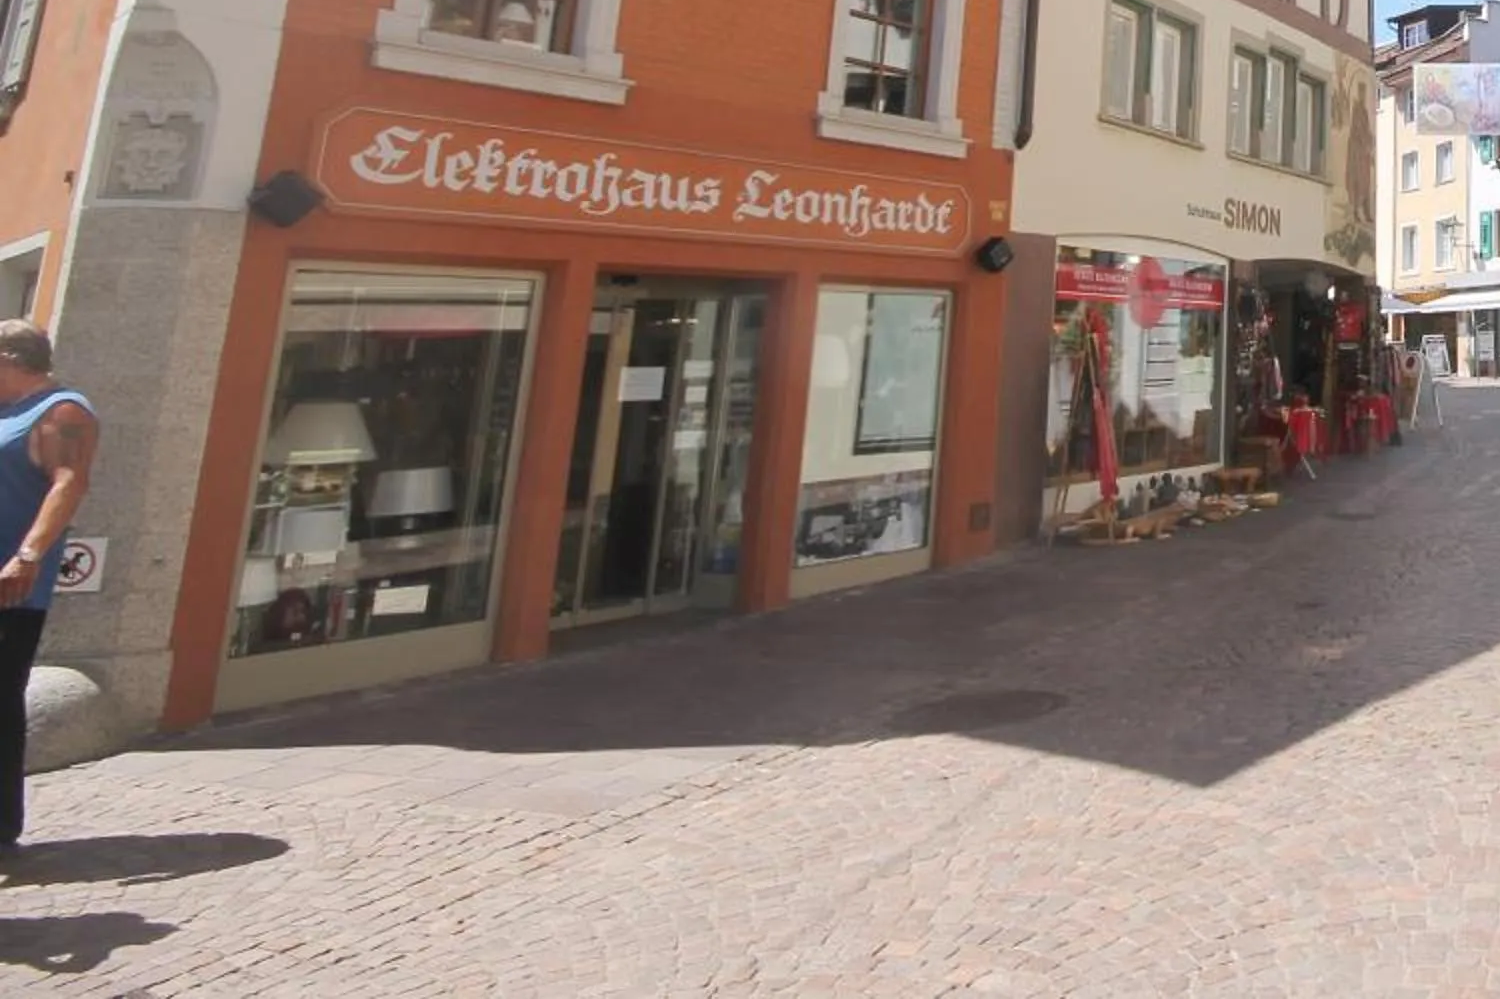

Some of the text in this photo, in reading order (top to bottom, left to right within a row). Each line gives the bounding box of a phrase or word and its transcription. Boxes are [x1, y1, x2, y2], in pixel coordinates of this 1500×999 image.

[349, 125, 955, 238] Elektrohaus Leonhardt
[1223, 197, 1281, 237] SIMON
